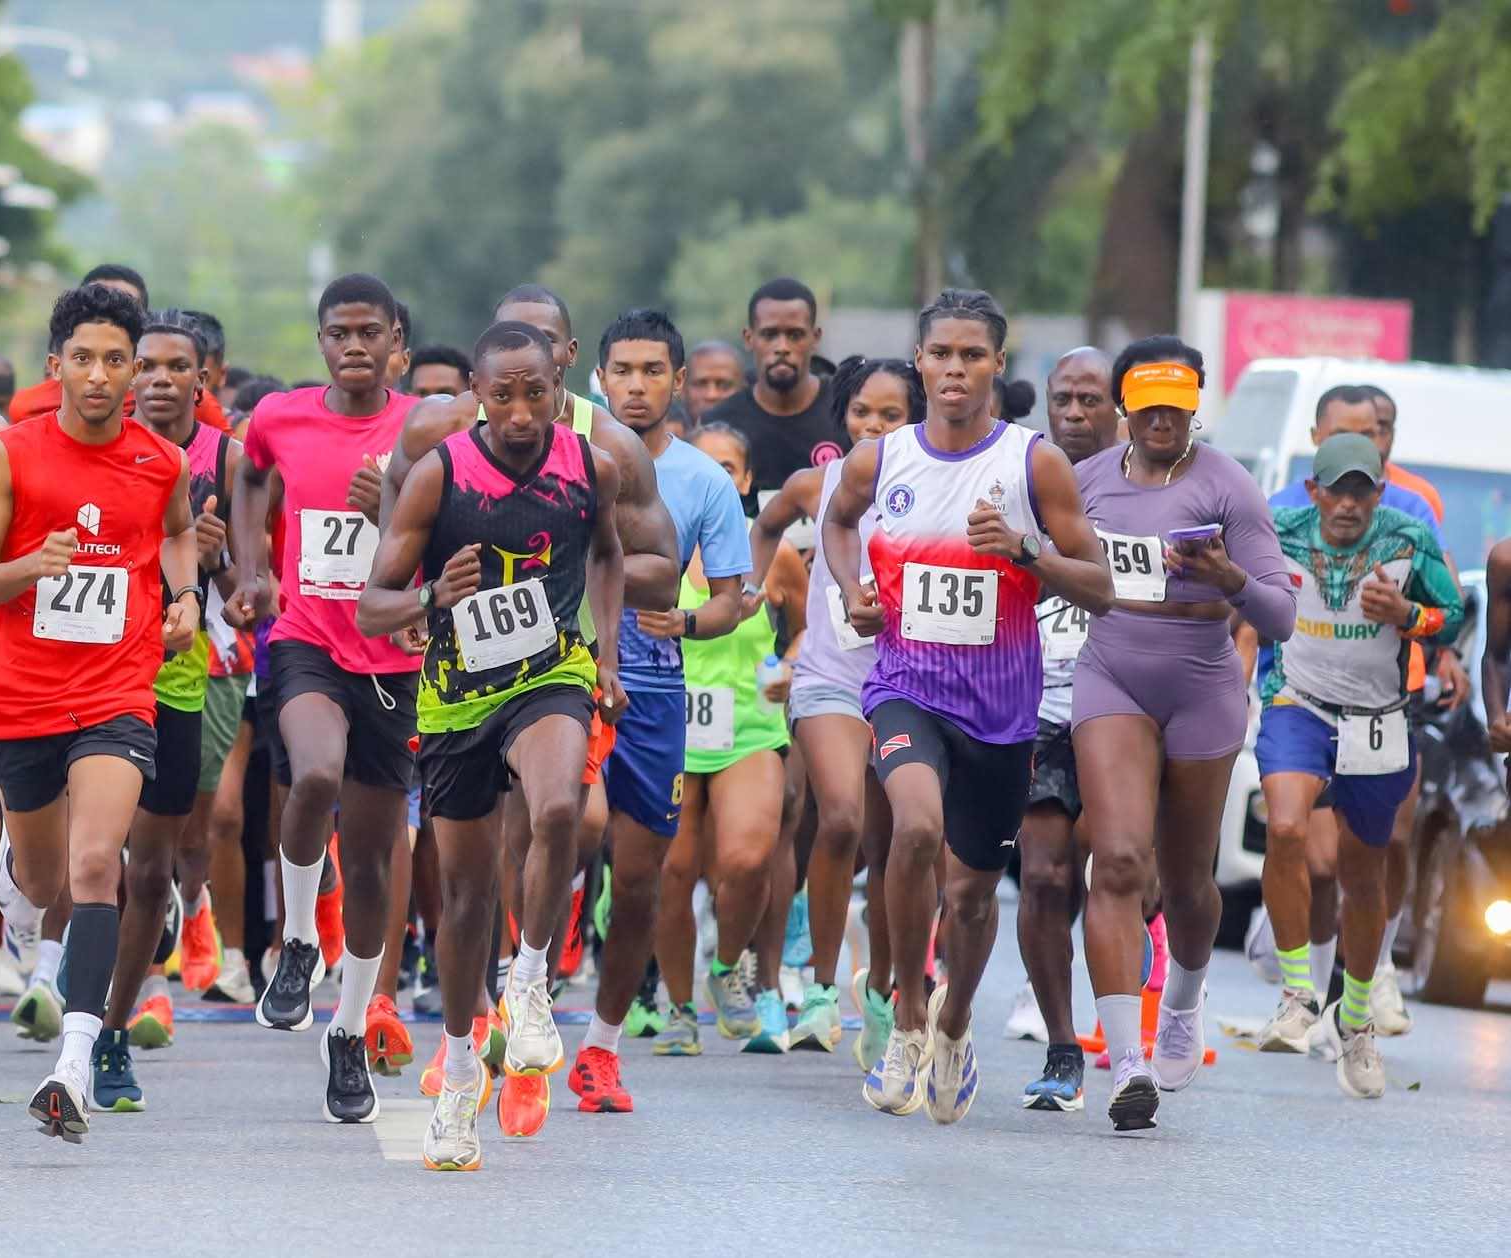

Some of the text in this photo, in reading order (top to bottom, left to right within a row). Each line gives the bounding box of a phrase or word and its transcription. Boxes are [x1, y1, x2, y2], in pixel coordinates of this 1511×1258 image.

[323, 516, 365, 556] 27
[50, 571, 116, 615] 274
[917, 571, 985, 618] 135
[467, 587, 539, 642] 169
[1297, 616, 1382, 640] SUBWAY
[1369, 715, 1383, 750] 6
